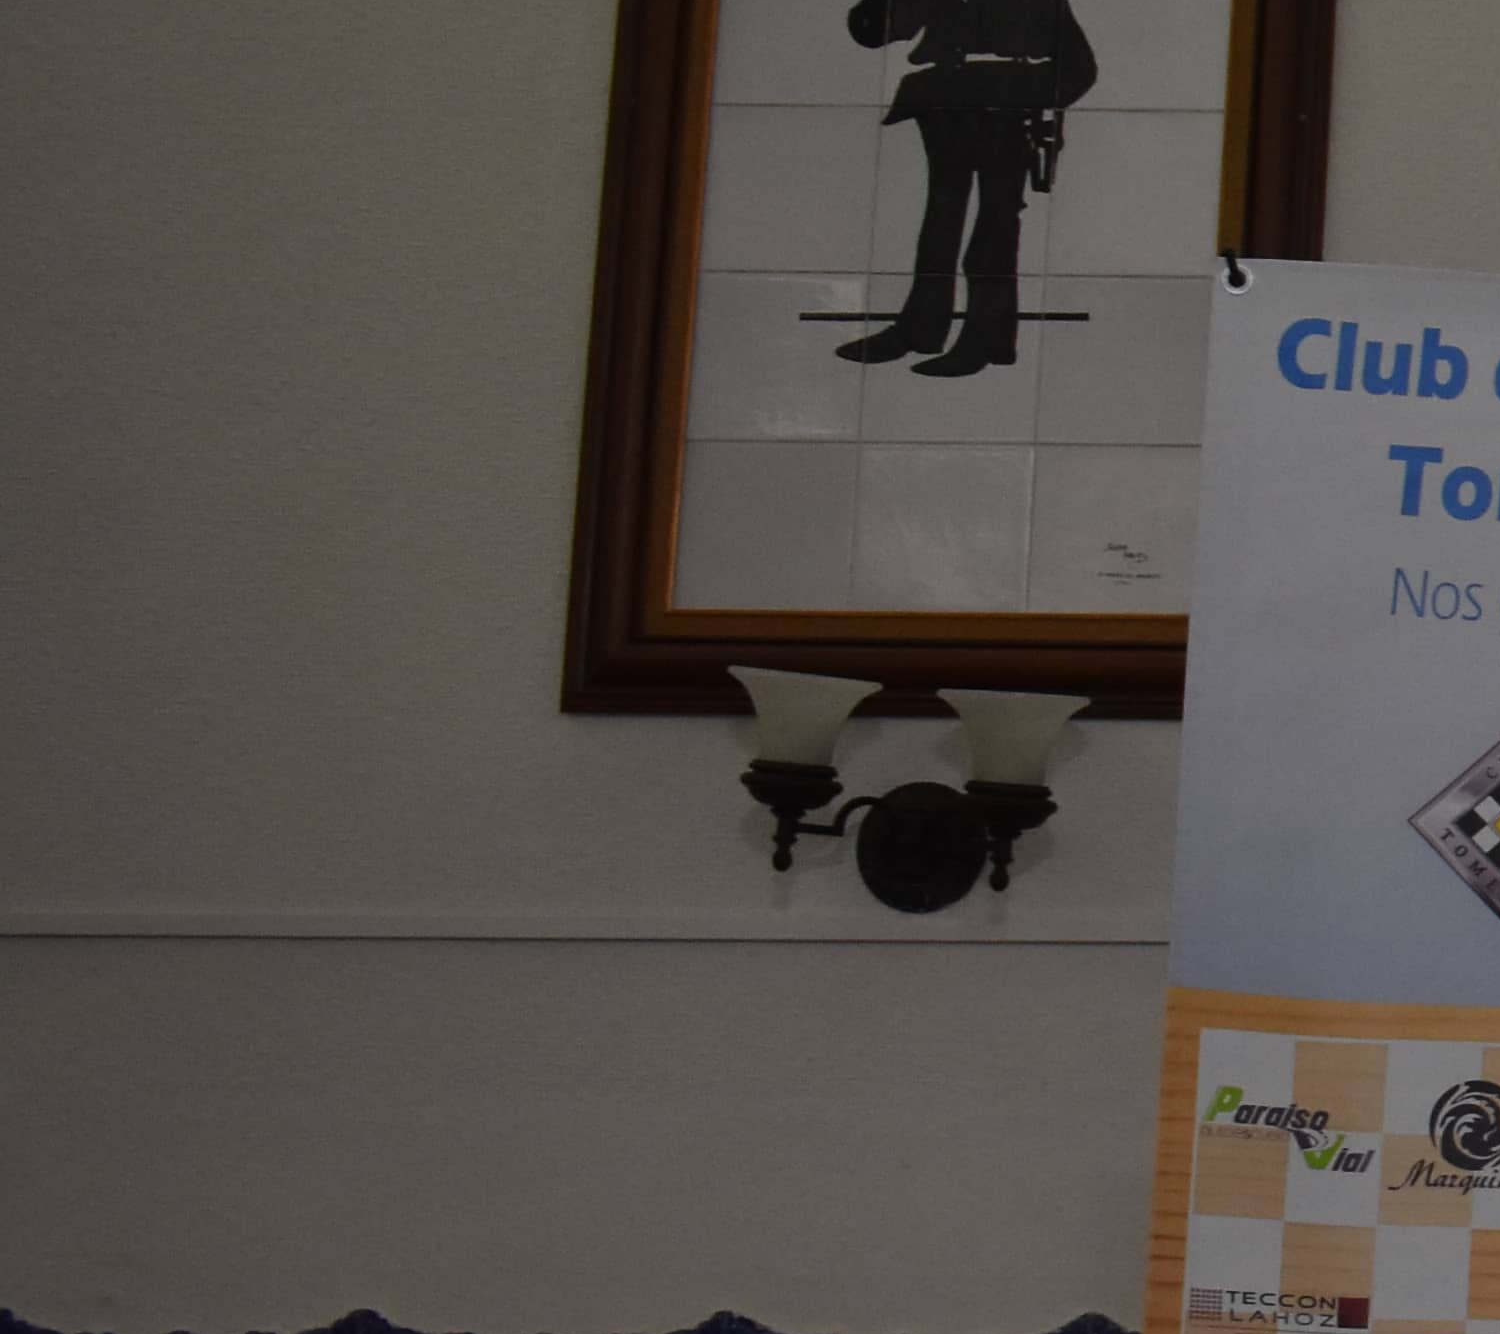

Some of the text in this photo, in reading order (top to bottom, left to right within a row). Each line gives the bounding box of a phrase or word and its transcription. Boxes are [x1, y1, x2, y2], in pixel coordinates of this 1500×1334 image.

[1277, 317, 1469, 400] Club
[1390, 567, 1483, 622] Nos
[1226, 1290, 1337, 1310] TECCON
[1230, 1309, 1335, 1328] LAHOZ
